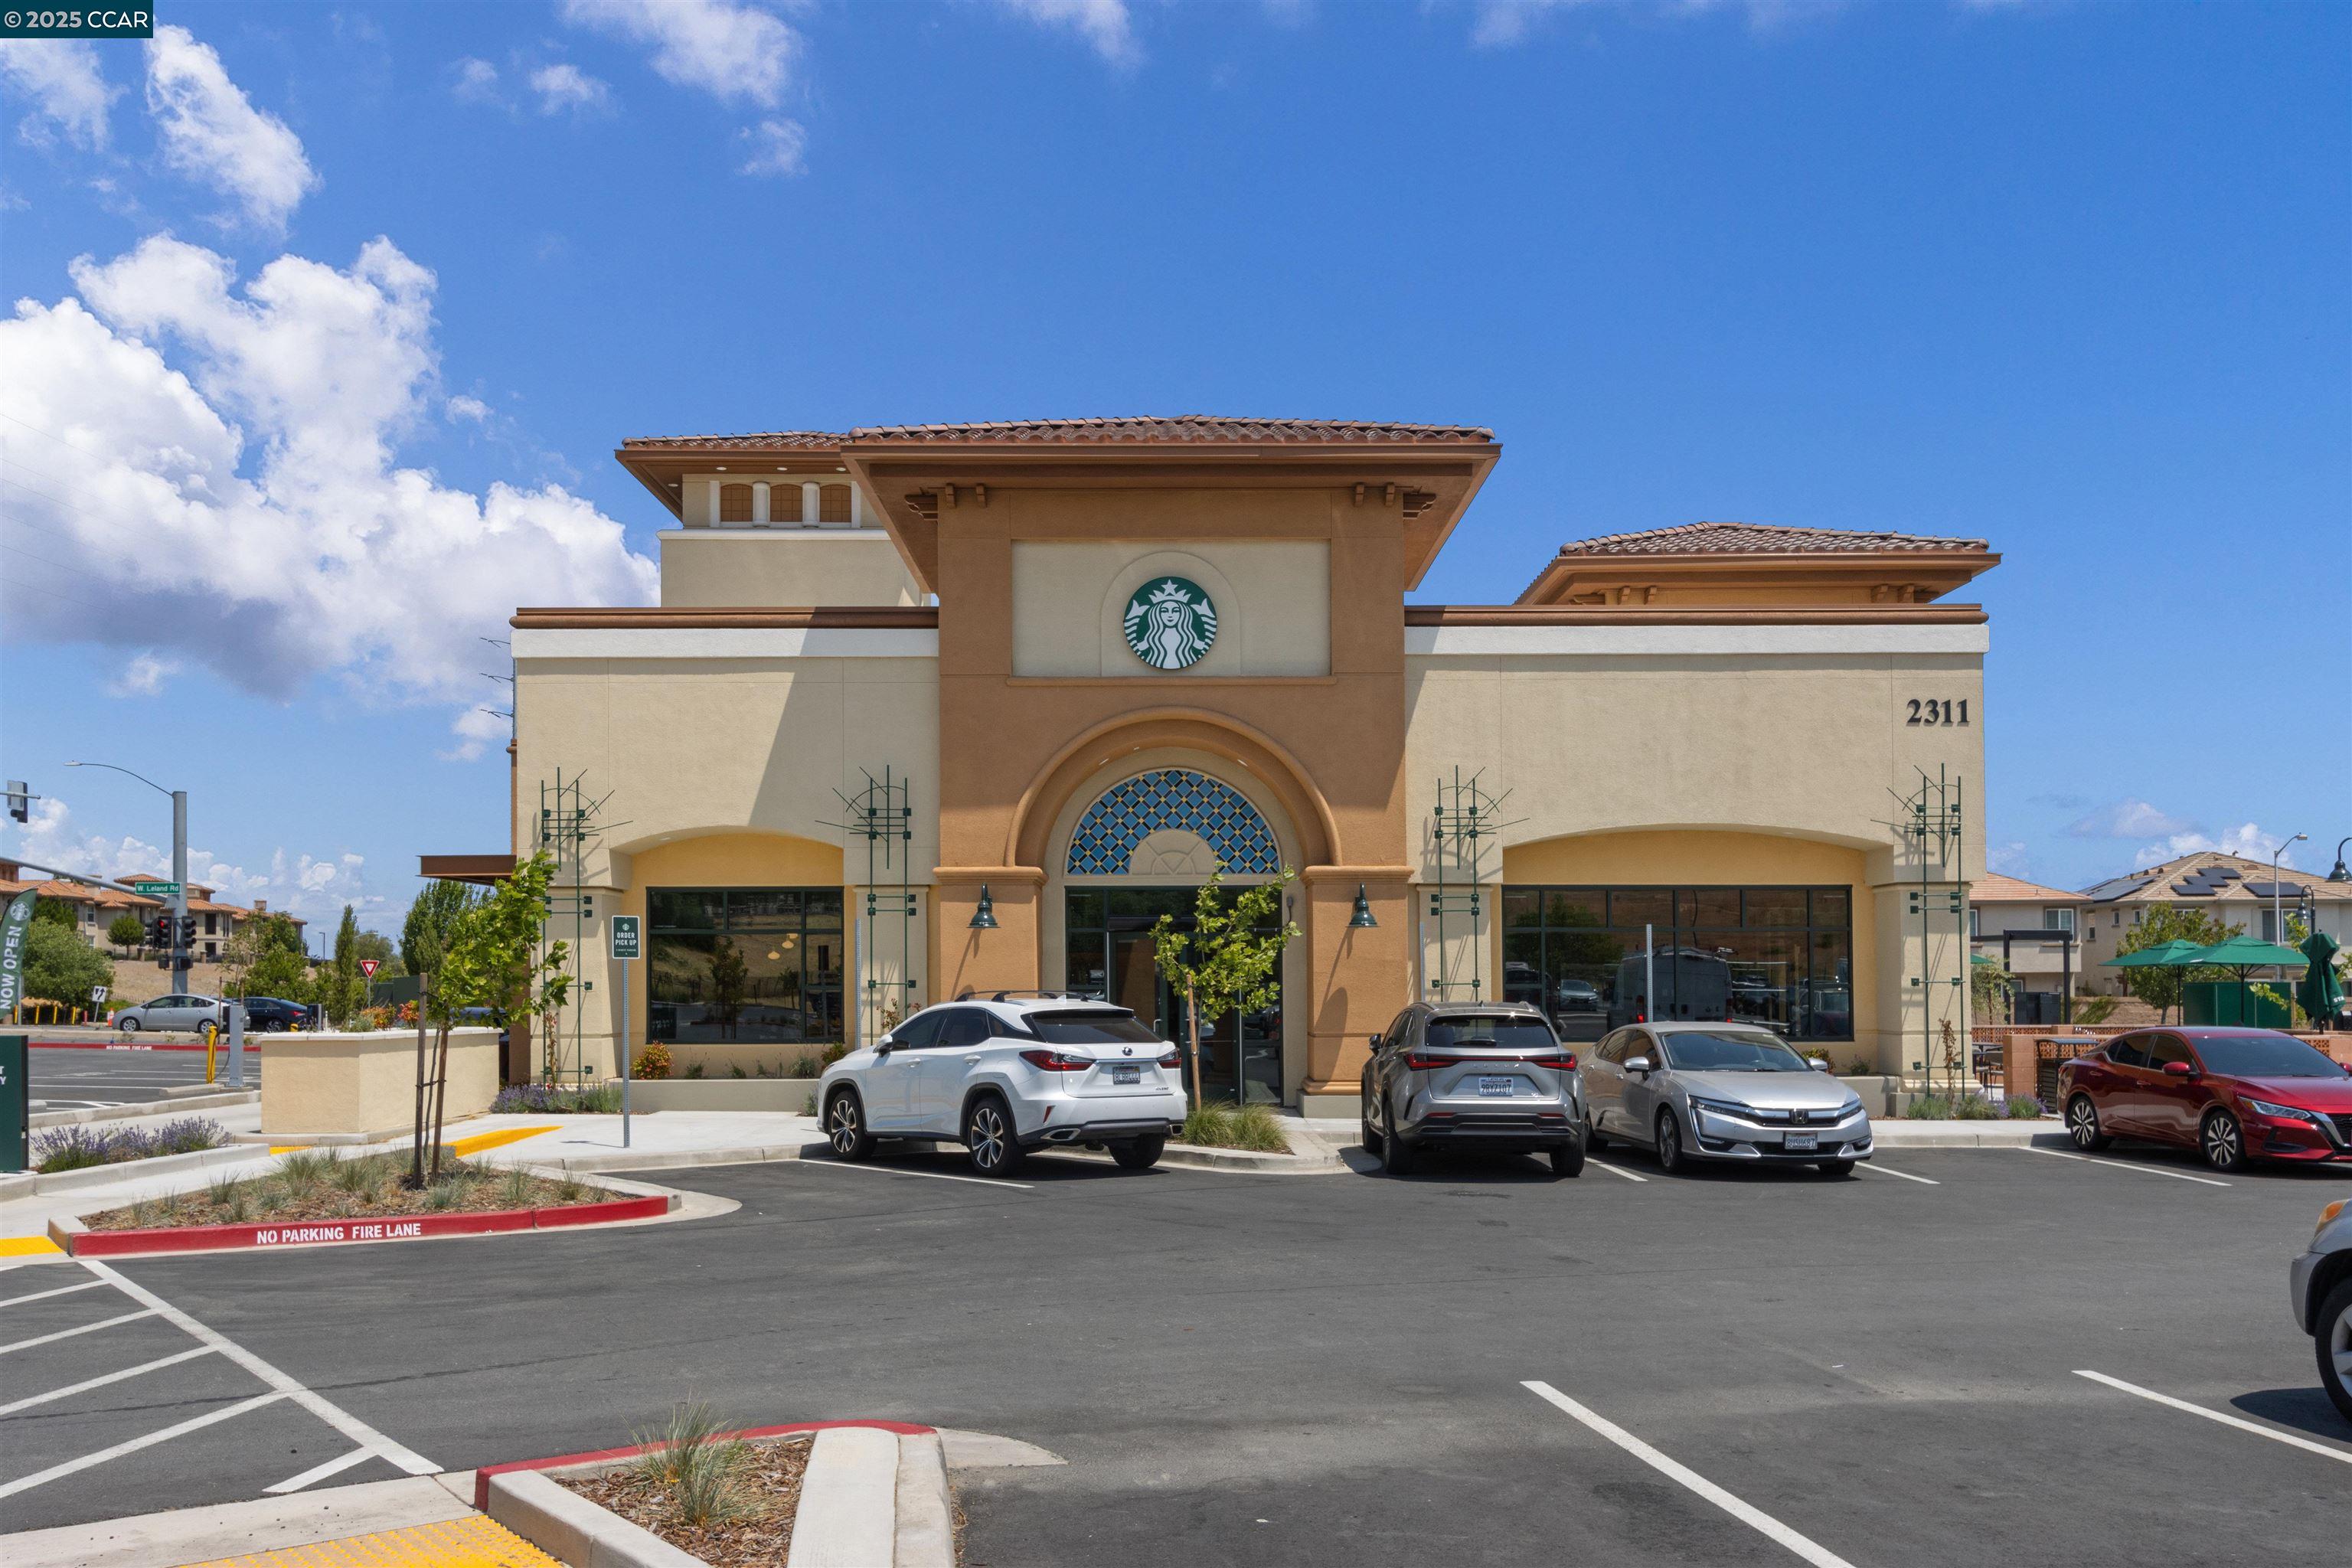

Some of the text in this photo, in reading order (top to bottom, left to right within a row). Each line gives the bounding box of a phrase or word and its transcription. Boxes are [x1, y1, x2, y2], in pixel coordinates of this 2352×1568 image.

[1906, 698, 1971, 724] 2311
[0, 926, 22, 1010] NOW OPEN
[256, 1223, 421, 1244] NO PARKING FIRE LANE
